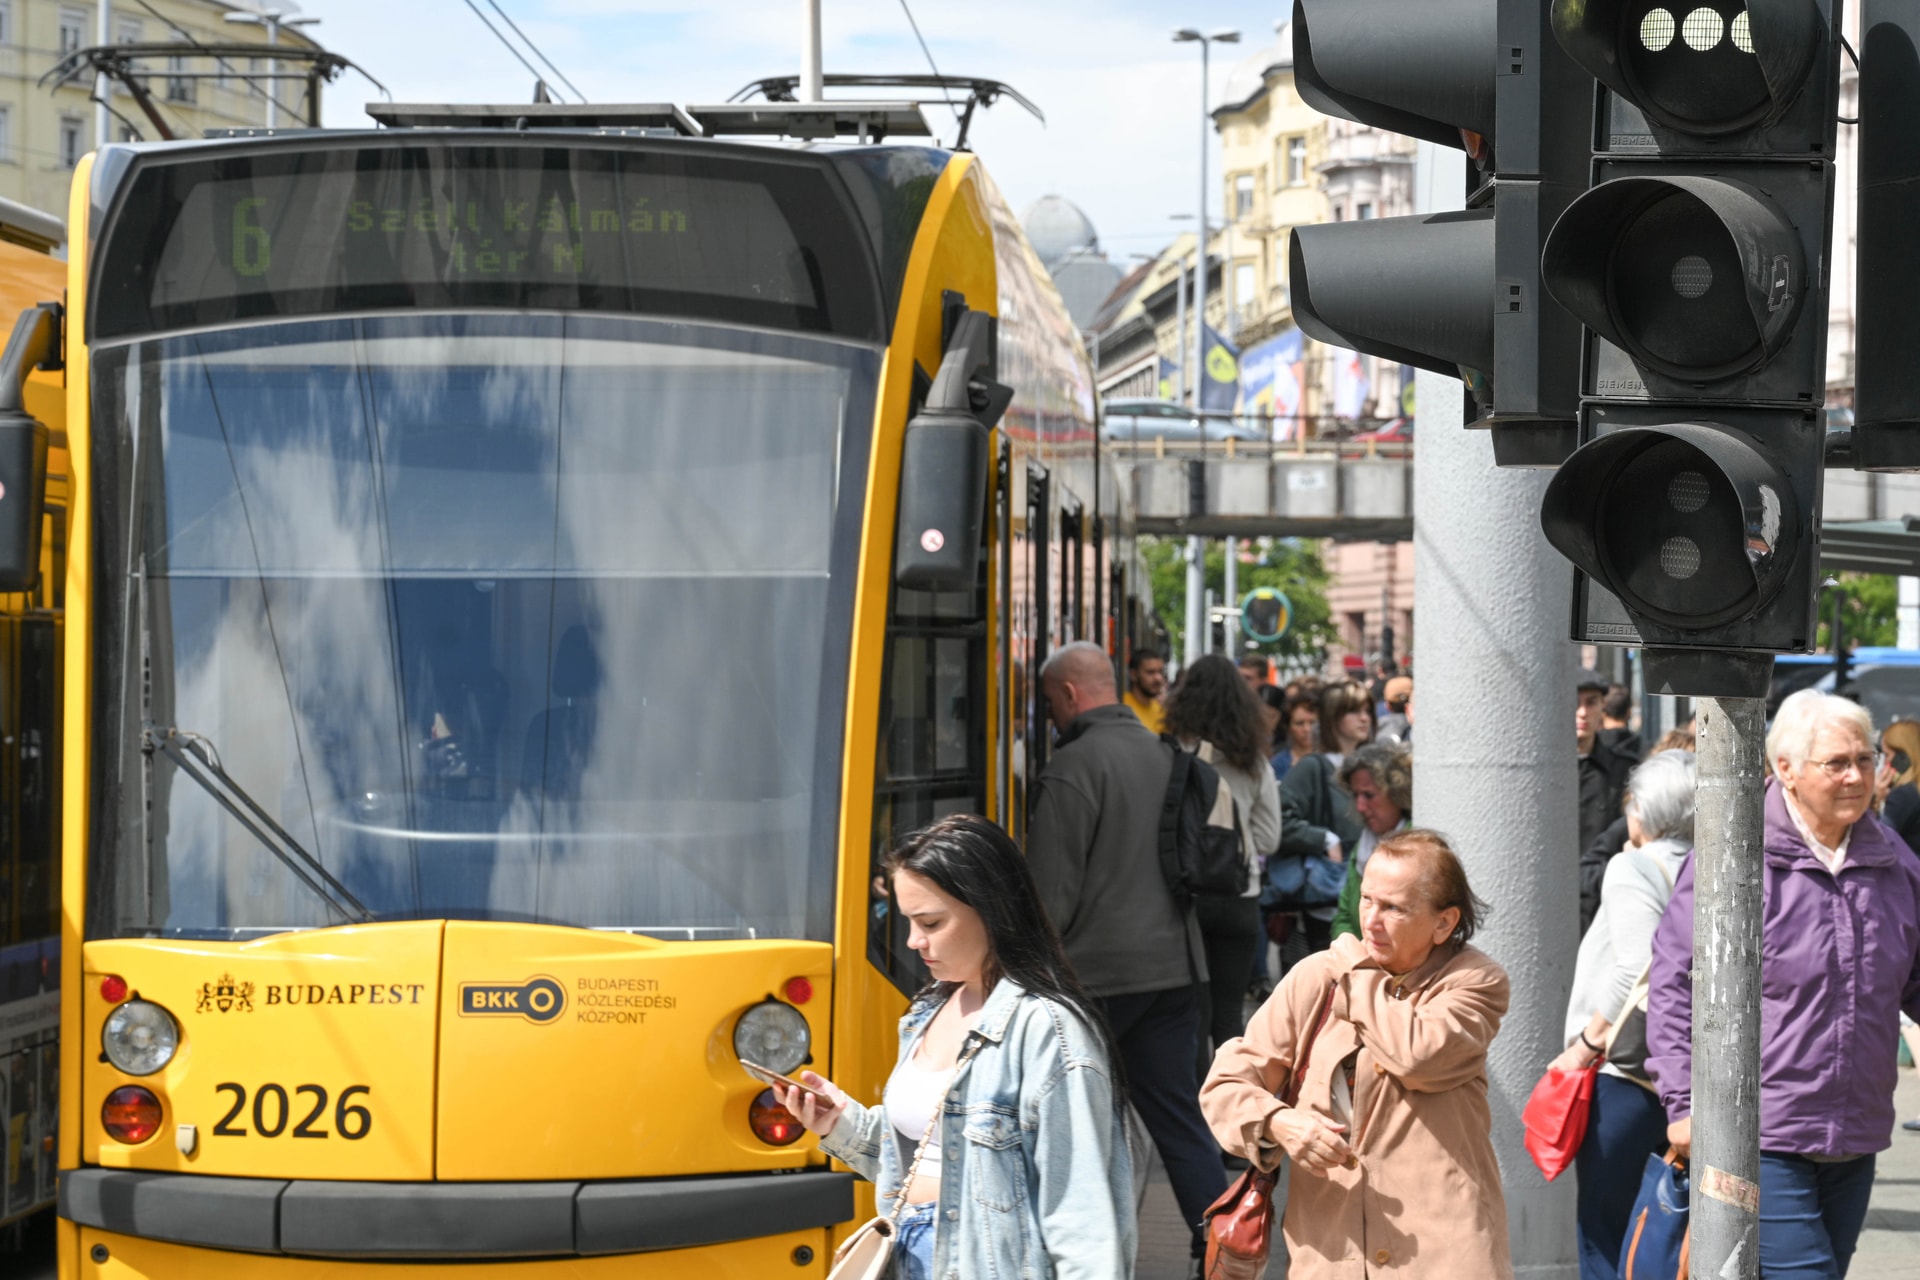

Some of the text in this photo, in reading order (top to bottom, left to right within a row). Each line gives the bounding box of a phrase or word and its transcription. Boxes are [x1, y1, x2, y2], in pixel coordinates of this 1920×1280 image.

[349, 197, 687, 233] Széll Kálmán
[232, 198, 271, 277] 6
[452, 238, 585, 274] tér M
[265, 983, 425, 1006] BUDAPEST
[577, 977, 659, 993] BUDAPESTI
[471, 991, 519, 1009] BKK
[577, 993, 677, 1009] KÖZLEKEDÉSI
[577, 1010, 647, 1025] KÖZPONT
[212, 1081, 372, 1141] 2026
